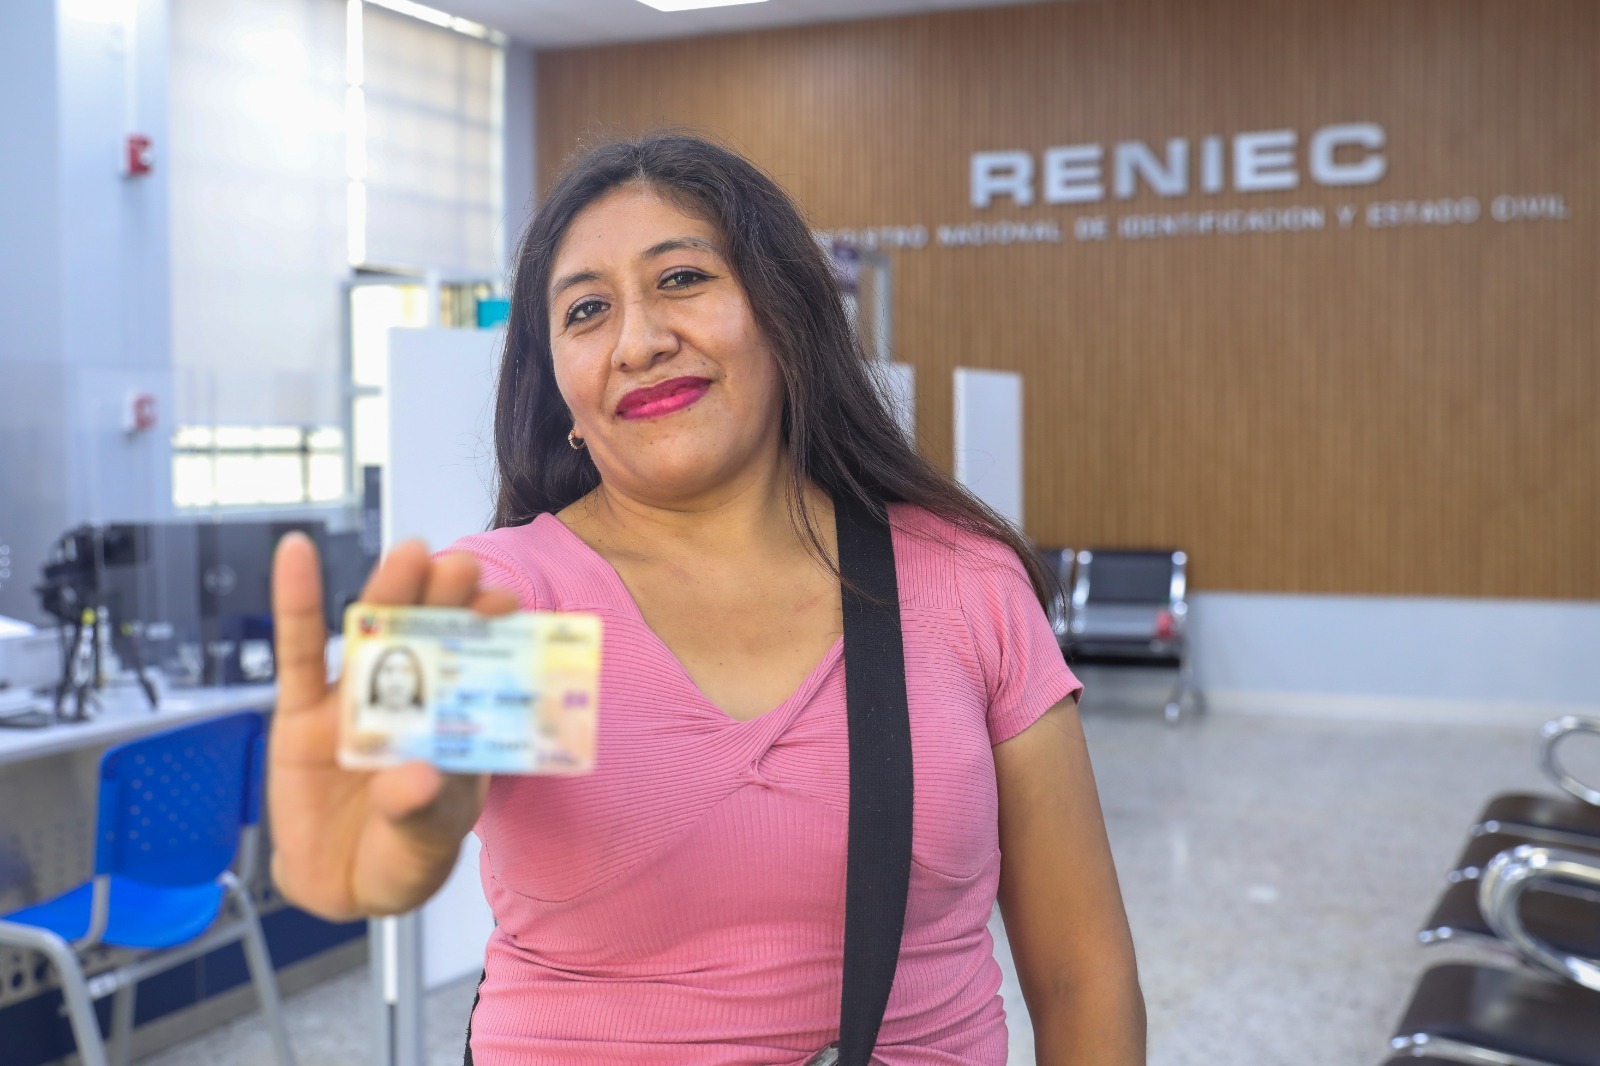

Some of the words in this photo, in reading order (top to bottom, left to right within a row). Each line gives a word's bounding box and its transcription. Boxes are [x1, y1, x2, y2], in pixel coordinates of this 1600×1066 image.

[970, 122, 1387, 208] RENIEC
[937, 220, 1062, 246] NACIONAL
[1074, 215, 1109, 241] DE
[1336, 203, 1357, 229] Y
[1366, 196, 1482, 228] ESTADO
[1491, 194, 1571, 222] CIVIL
